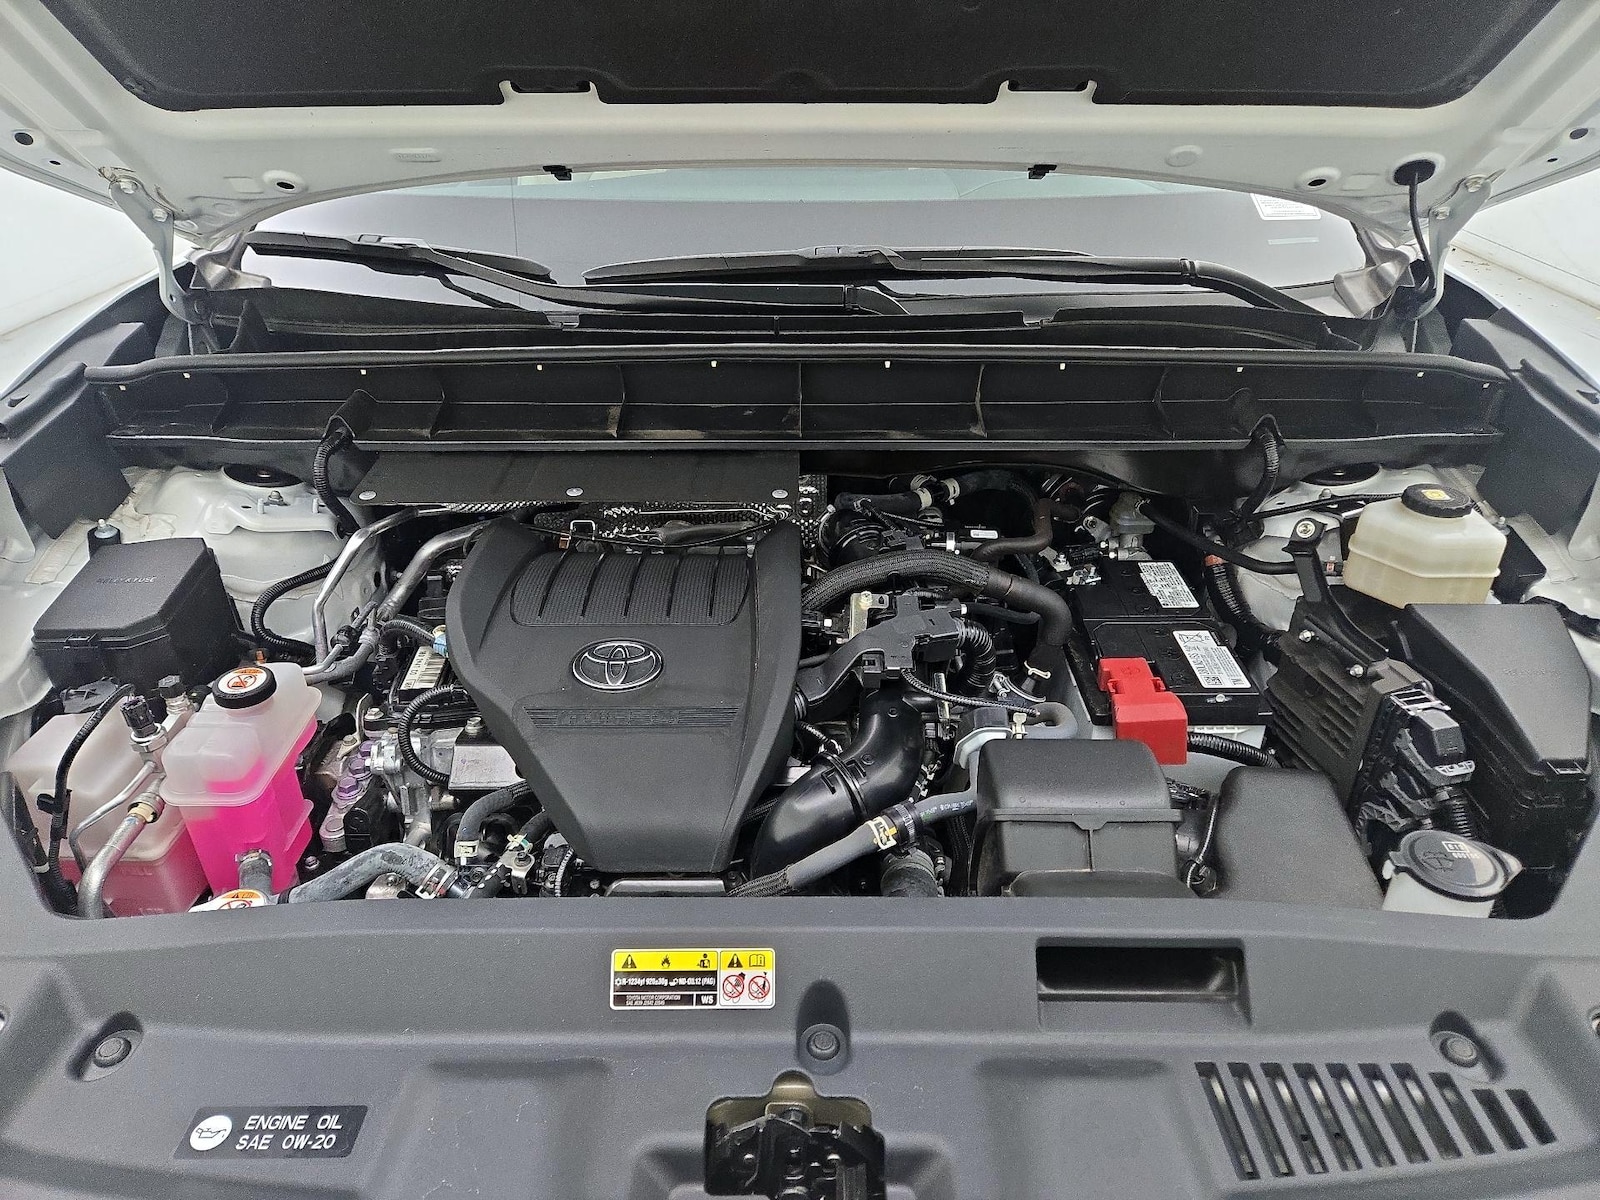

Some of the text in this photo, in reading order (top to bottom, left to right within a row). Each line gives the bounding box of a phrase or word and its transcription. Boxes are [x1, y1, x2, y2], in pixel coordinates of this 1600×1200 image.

[701, 995, 714, 1005] WS
[244, 1115, 343, 1130] ENGINE OIL
[235, 1134, 337, 1150] SAE 0W-20
